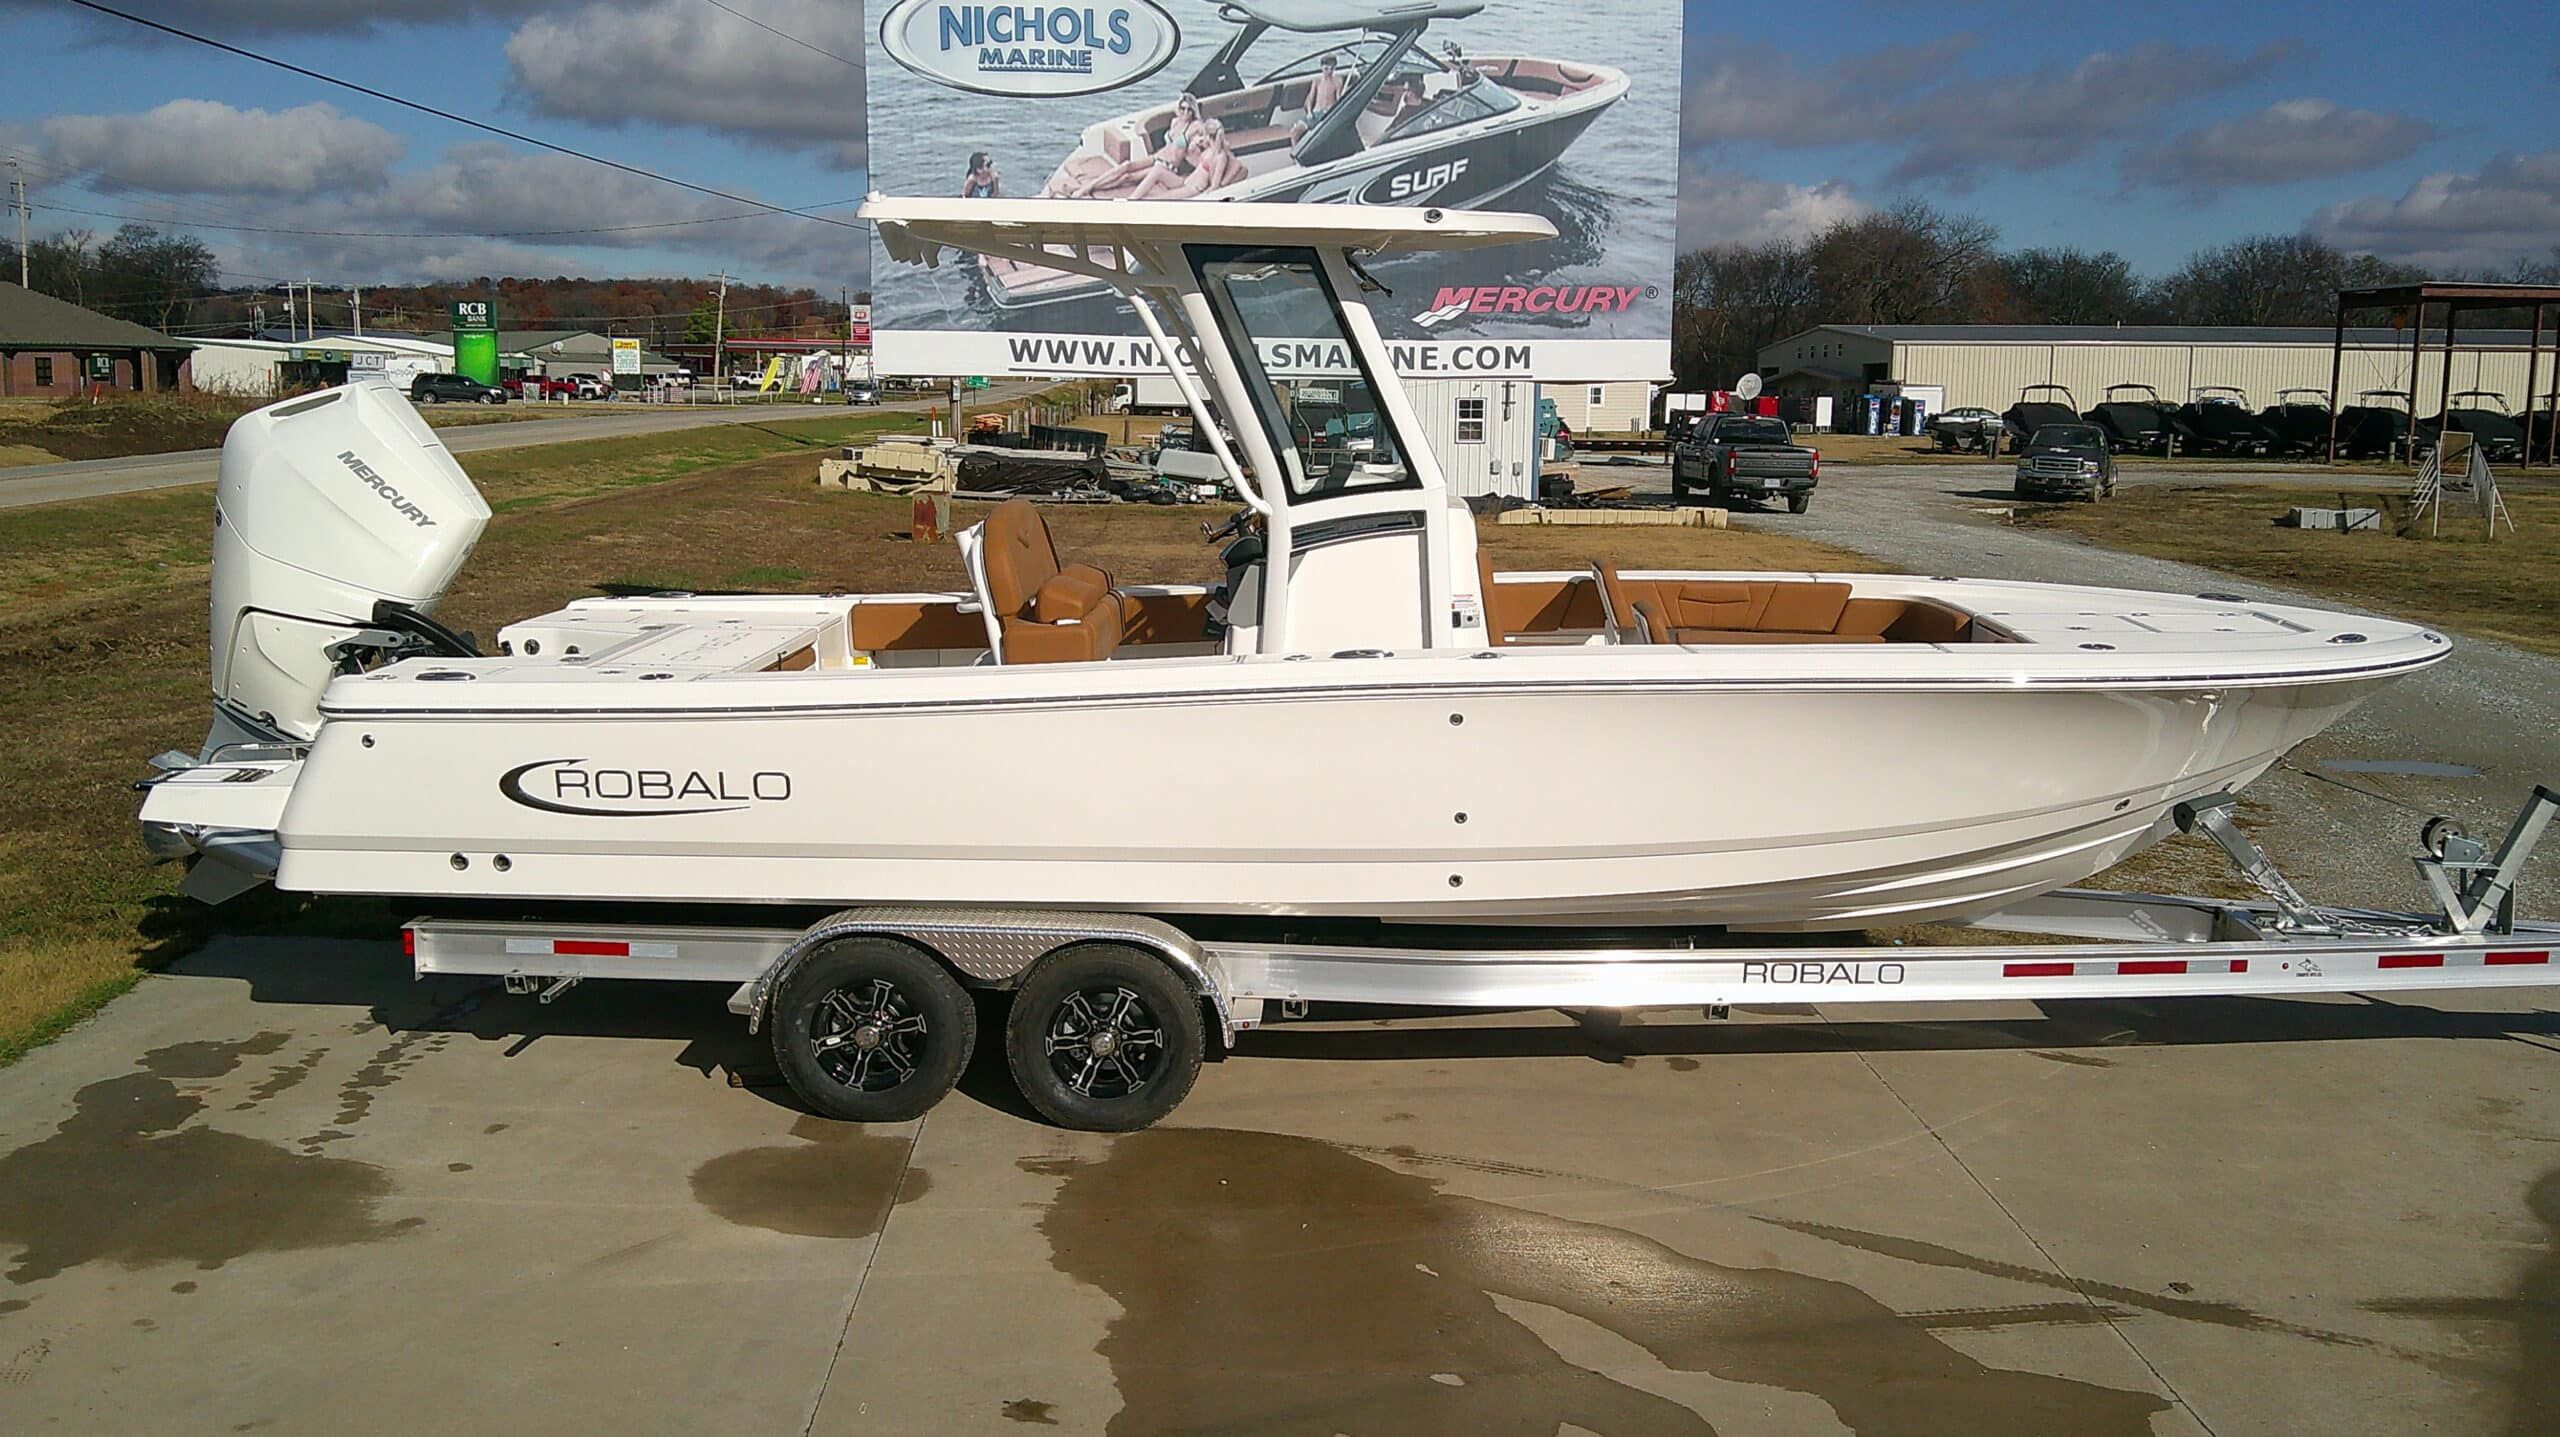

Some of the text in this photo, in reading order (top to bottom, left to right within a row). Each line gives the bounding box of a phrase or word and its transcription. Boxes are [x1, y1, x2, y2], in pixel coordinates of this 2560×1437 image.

[939, 5, 1132, 54] NICHOLS
[978, 48, 1092, 67] MARINE
[1390, 158, 1469, 199] SURF
[458, 302, 487, 315] RCB
[1431, 287, 1643, 314] MERCURY
[356, 356, 381, 367] JCT
[337, 450, 438, 527] MERCURY
[554, 769, 791, 801] ROBALO
[1743, 962, 1904, 984] ROBALO
